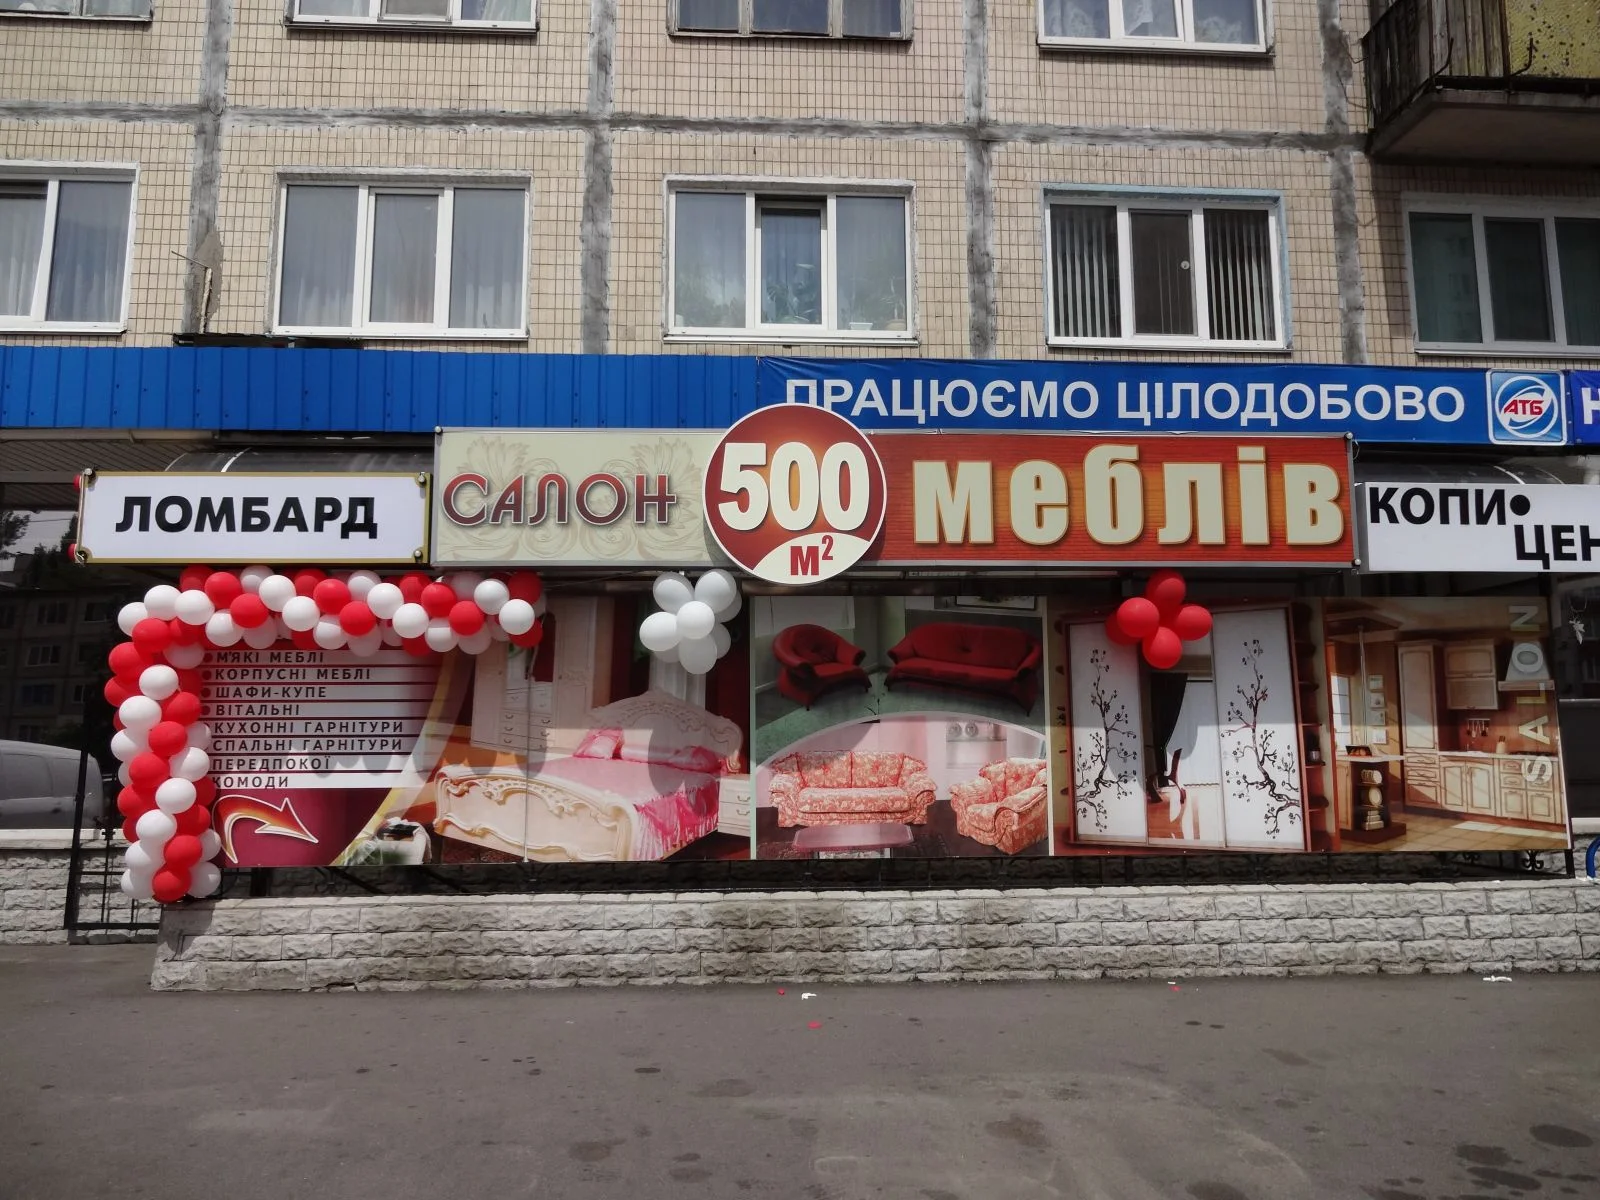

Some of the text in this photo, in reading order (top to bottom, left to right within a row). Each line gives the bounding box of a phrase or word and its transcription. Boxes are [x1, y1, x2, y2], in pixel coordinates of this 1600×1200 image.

[786, 379, 1465, 426] ПРАЦЮЄМО ЦІЛОДОБОВО
[1503, 399, 1544, 415] АТБ
[718, 442, 870, 531] 500
[912, 444, 1344, 545] меблів
[442, 473, 677, 526] САЛОН
[115, 496, 378, 539] ЛОМБАРД
[270, 651, 324, 663] МЕБЛІ
[215, 668, 371, 680] КОРПУСНІ МЕБЛІ
[215, 686, 327, 698] ШАФИ-КУПЕ
[1508, 605, 1553, 783] SALON
[215, 704, 300, 716] ВІТАЛЬНІ
[214, 721, 403, 734] КУХОННІ ГАРНІТУРИ
[213, 739, 402, 752] СПАЛЬНІ ГАРНІТУРИ
[212, 755, 330, 772] ПЕРЕДПОКОЇ
[213, 776, 288, 788] КОМОДИ
